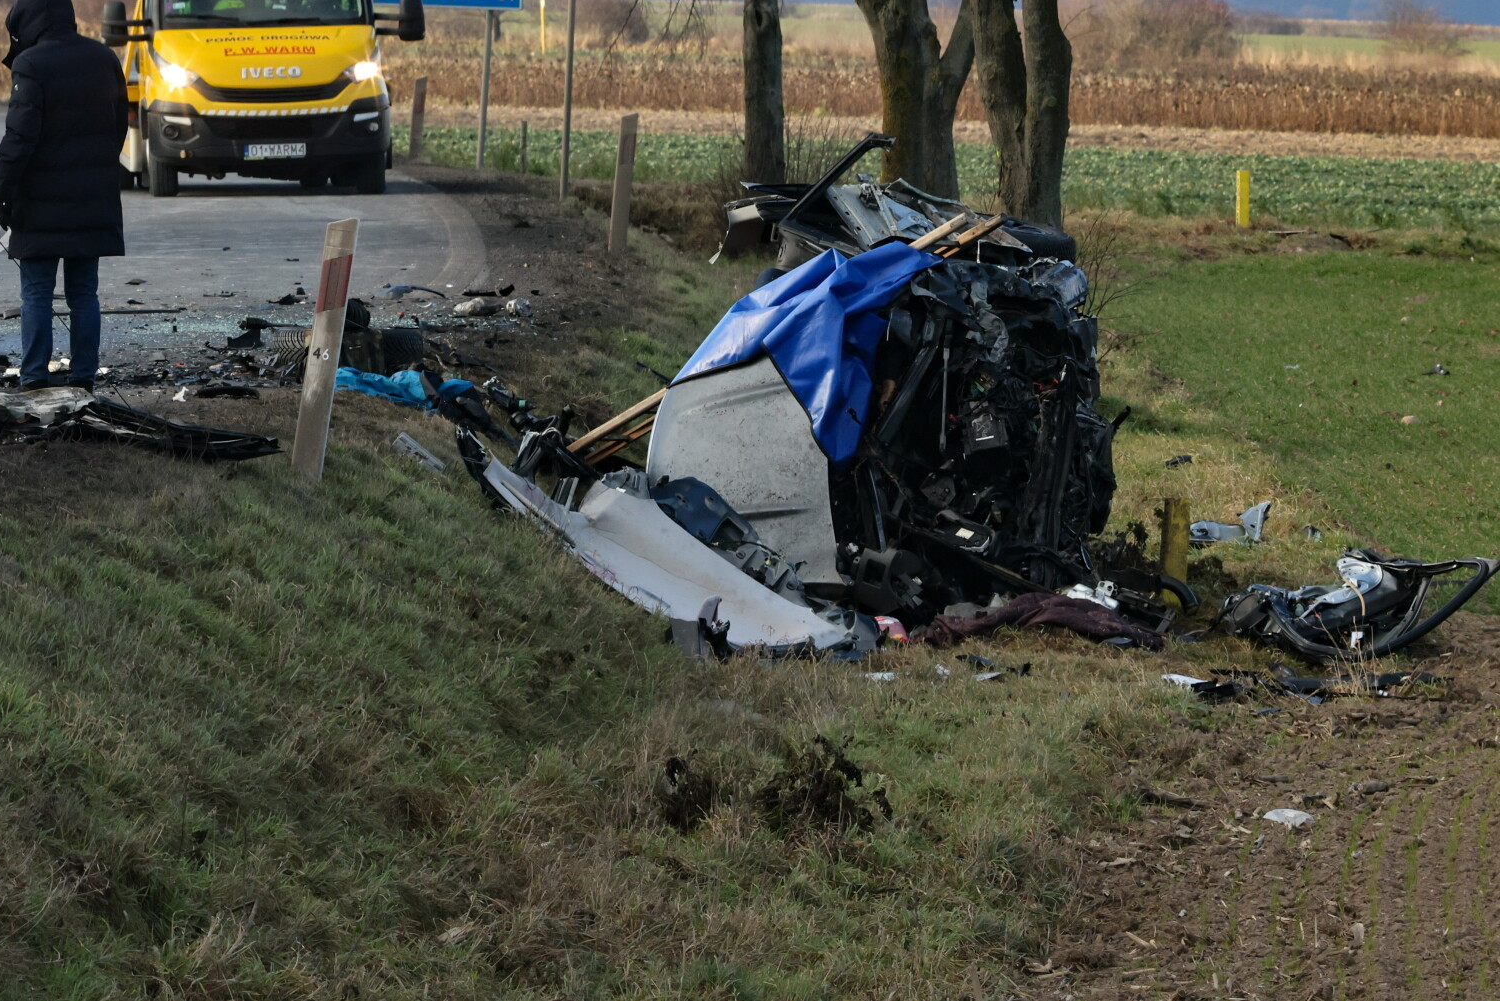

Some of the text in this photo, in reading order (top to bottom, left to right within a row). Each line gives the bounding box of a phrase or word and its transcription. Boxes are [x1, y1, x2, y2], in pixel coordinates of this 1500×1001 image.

[241, 47, 260, 55] W.
[265, 46, 316, 55] WARM
[241, 65, 302, 79] IVECO
[312, 347, 330, 361] 46
